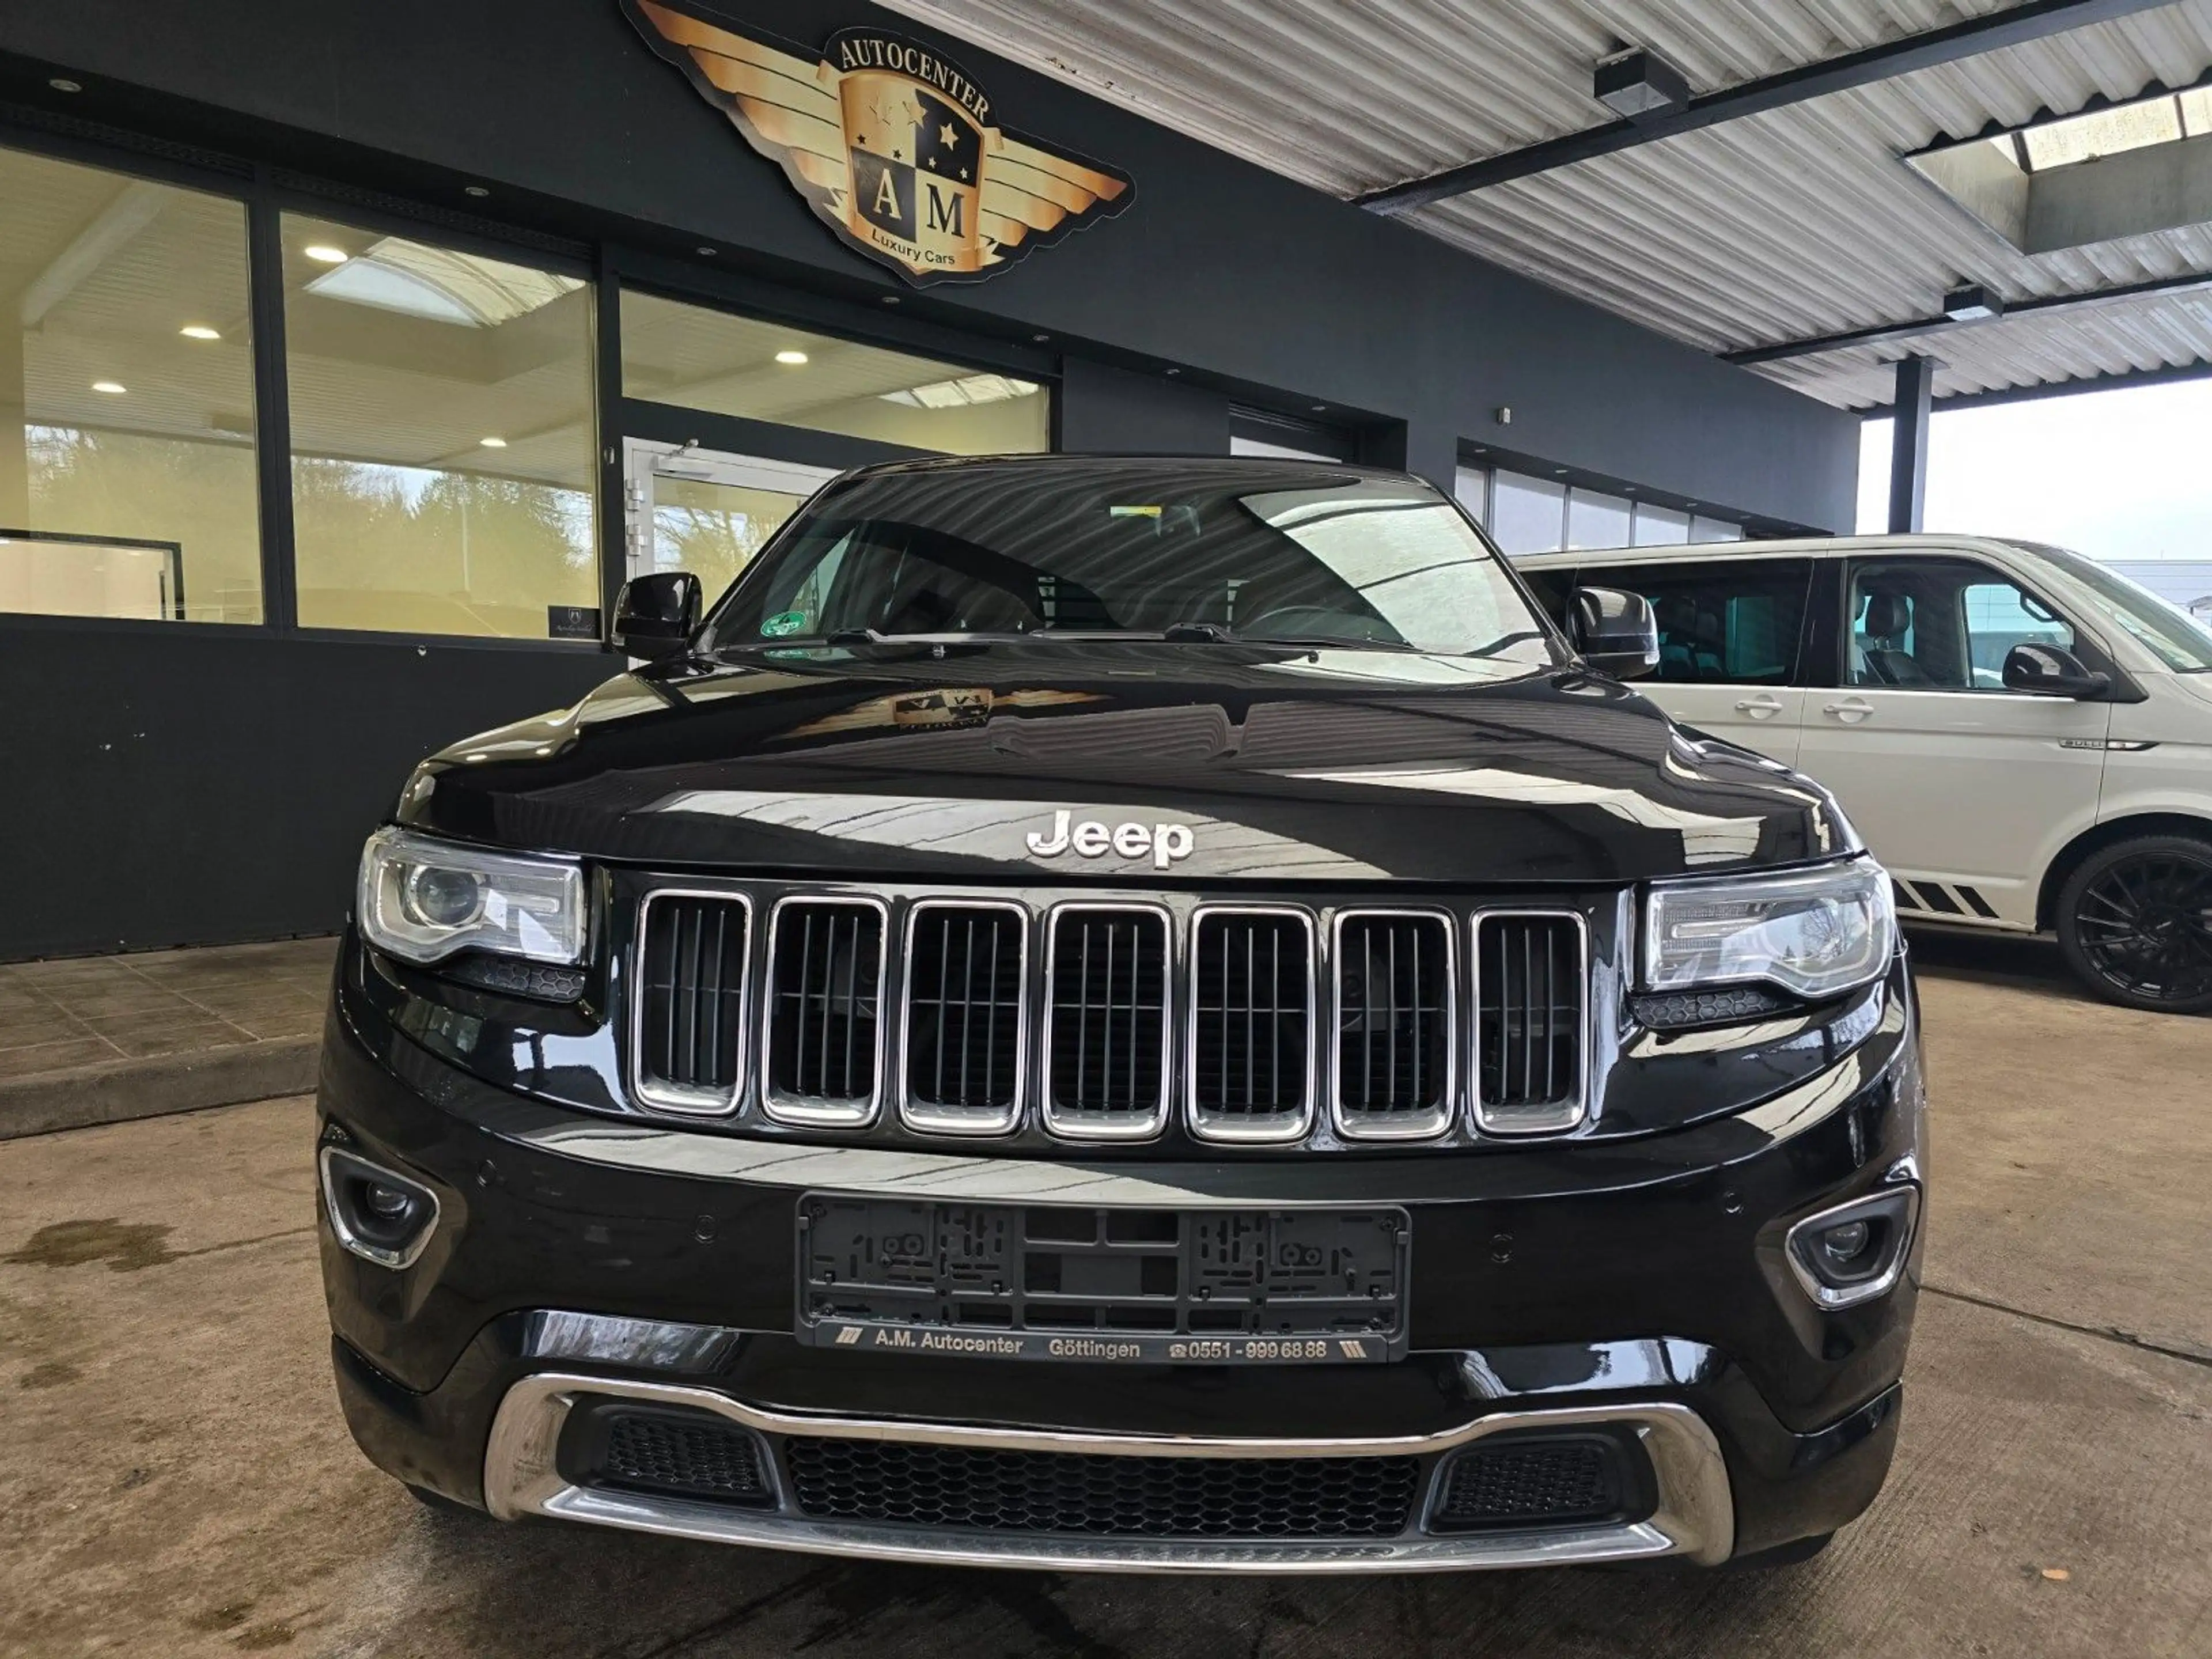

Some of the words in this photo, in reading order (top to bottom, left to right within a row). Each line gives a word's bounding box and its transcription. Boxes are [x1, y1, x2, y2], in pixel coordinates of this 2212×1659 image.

[840, 39, 990, 123] AUTOCENTER
[873, 168, 902, 221] A
[926, 183, 965, 238] M
[872, 228, 921, 262] Luxury
[925, 250, 955, 265] Cars
[1026, 809, 1195, 870] Jeep
[875, 1329, 916, 1347] A.M.
[921, 1332, 1024, 1353] Autocenter
[1049, 1338, 1141, 1360] Göttingen
